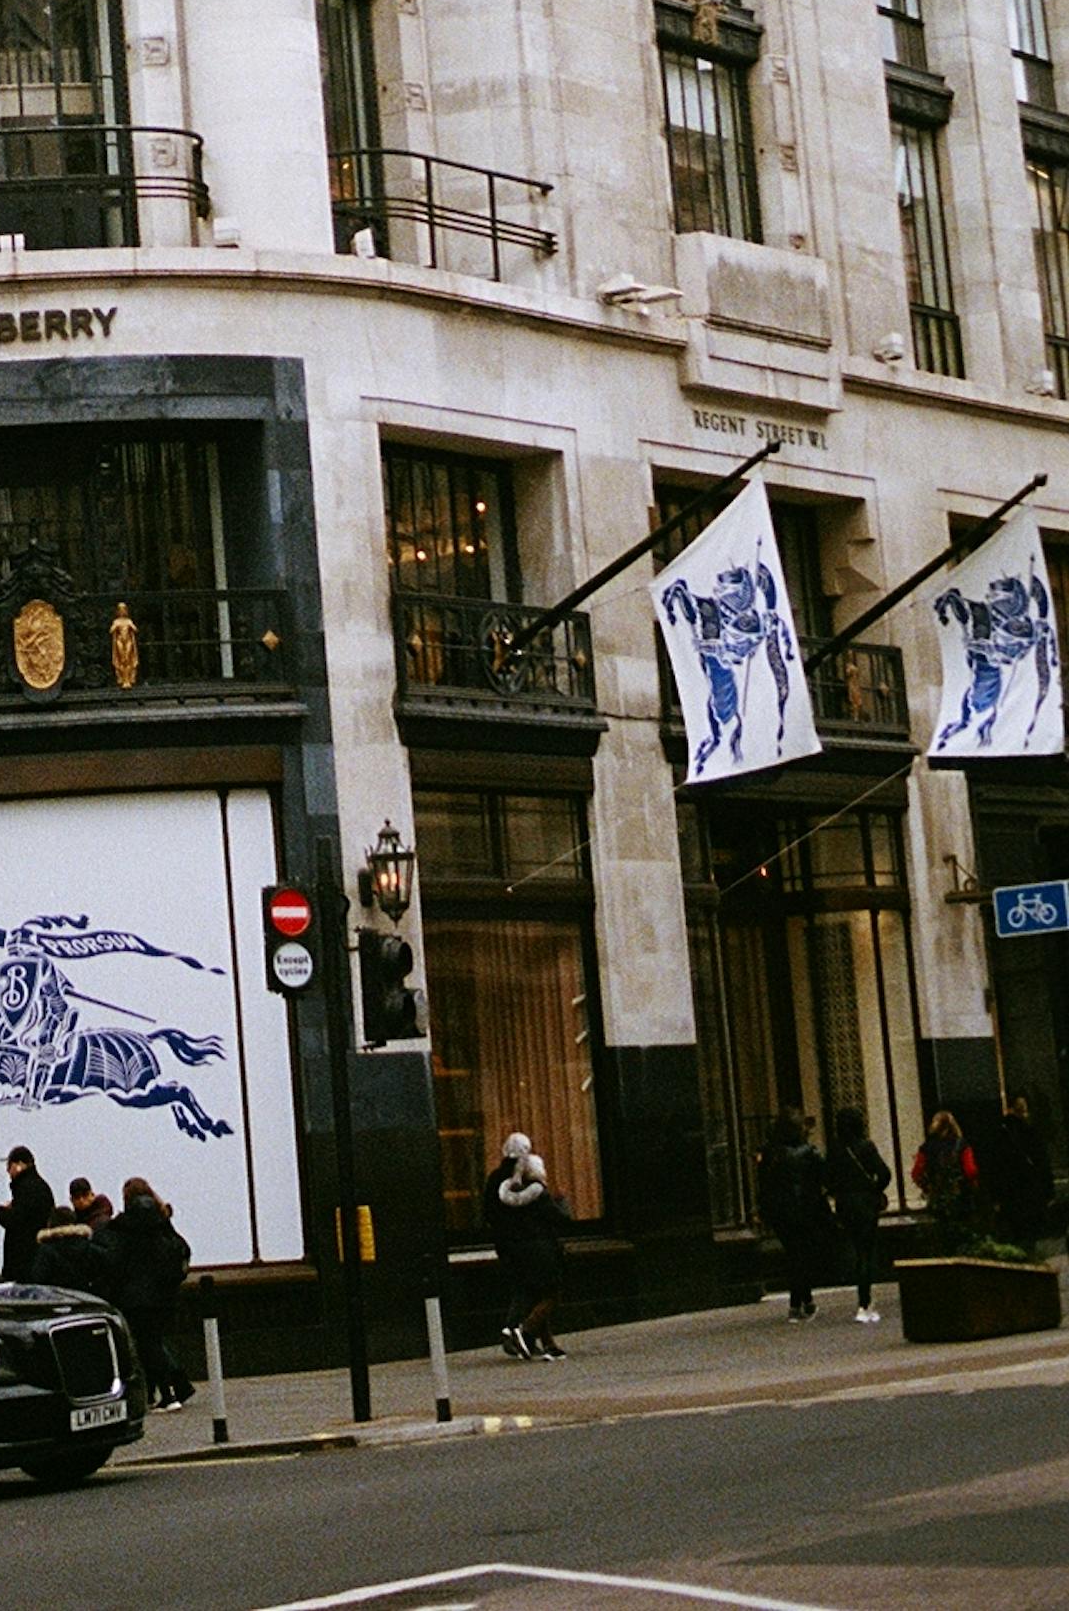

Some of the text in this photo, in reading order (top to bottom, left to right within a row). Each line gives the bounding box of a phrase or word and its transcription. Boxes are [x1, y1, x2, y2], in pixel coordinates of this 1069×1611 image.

[693, 410, 746, 436] REGENT
[756, 421, 804, 446] STREET
[40, 933, 145, 956] PRORSUM
[276, 954, 309, 966] Except
